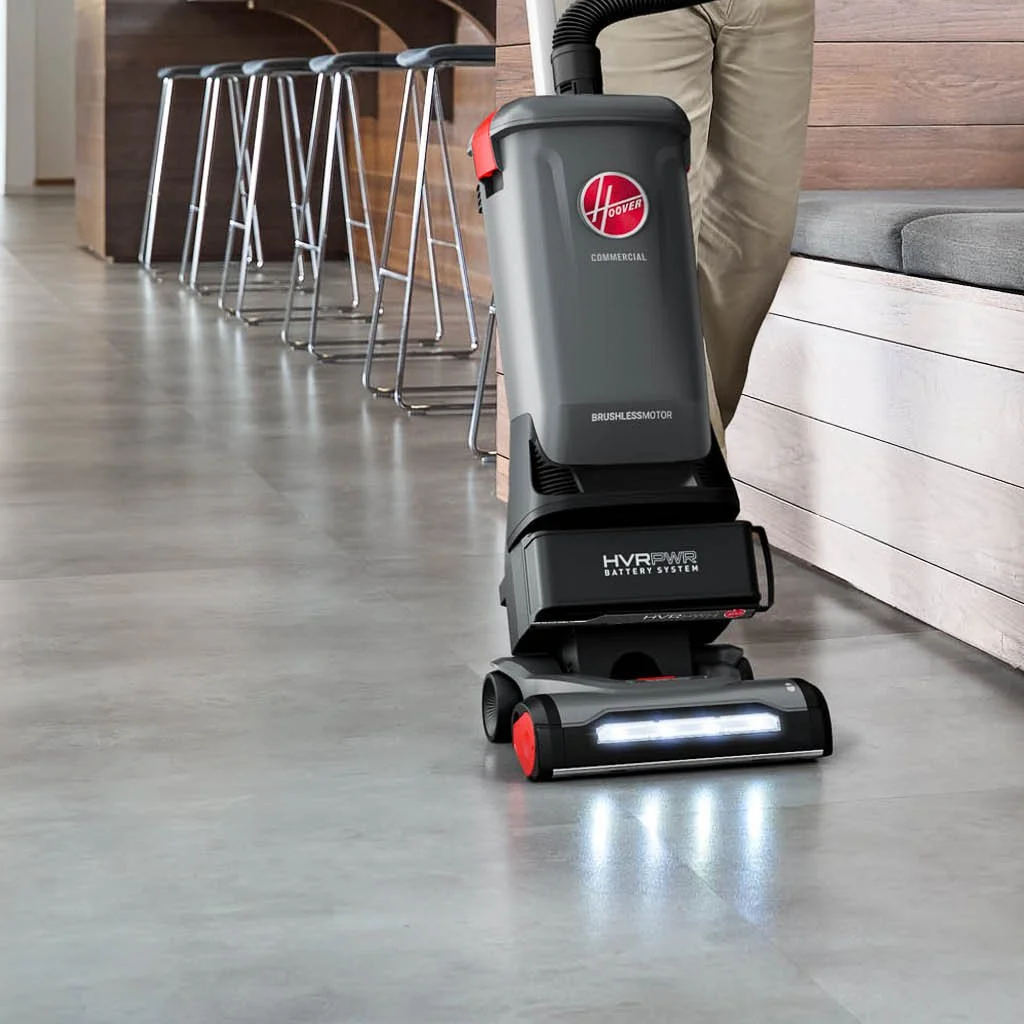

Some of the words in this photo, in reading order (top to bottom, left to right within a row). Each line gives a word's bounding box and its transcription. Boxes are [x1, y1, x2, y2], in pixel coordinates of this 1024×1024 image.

[584, 174, 643, 234] HOOVER
[591, 253, 648, 262] COMMERCIAL
[602, 550, 698, 568] HVRPWR
[604, 567, 652, 577] BATTERY
[657, 564, 699, 574] SYSTEM
